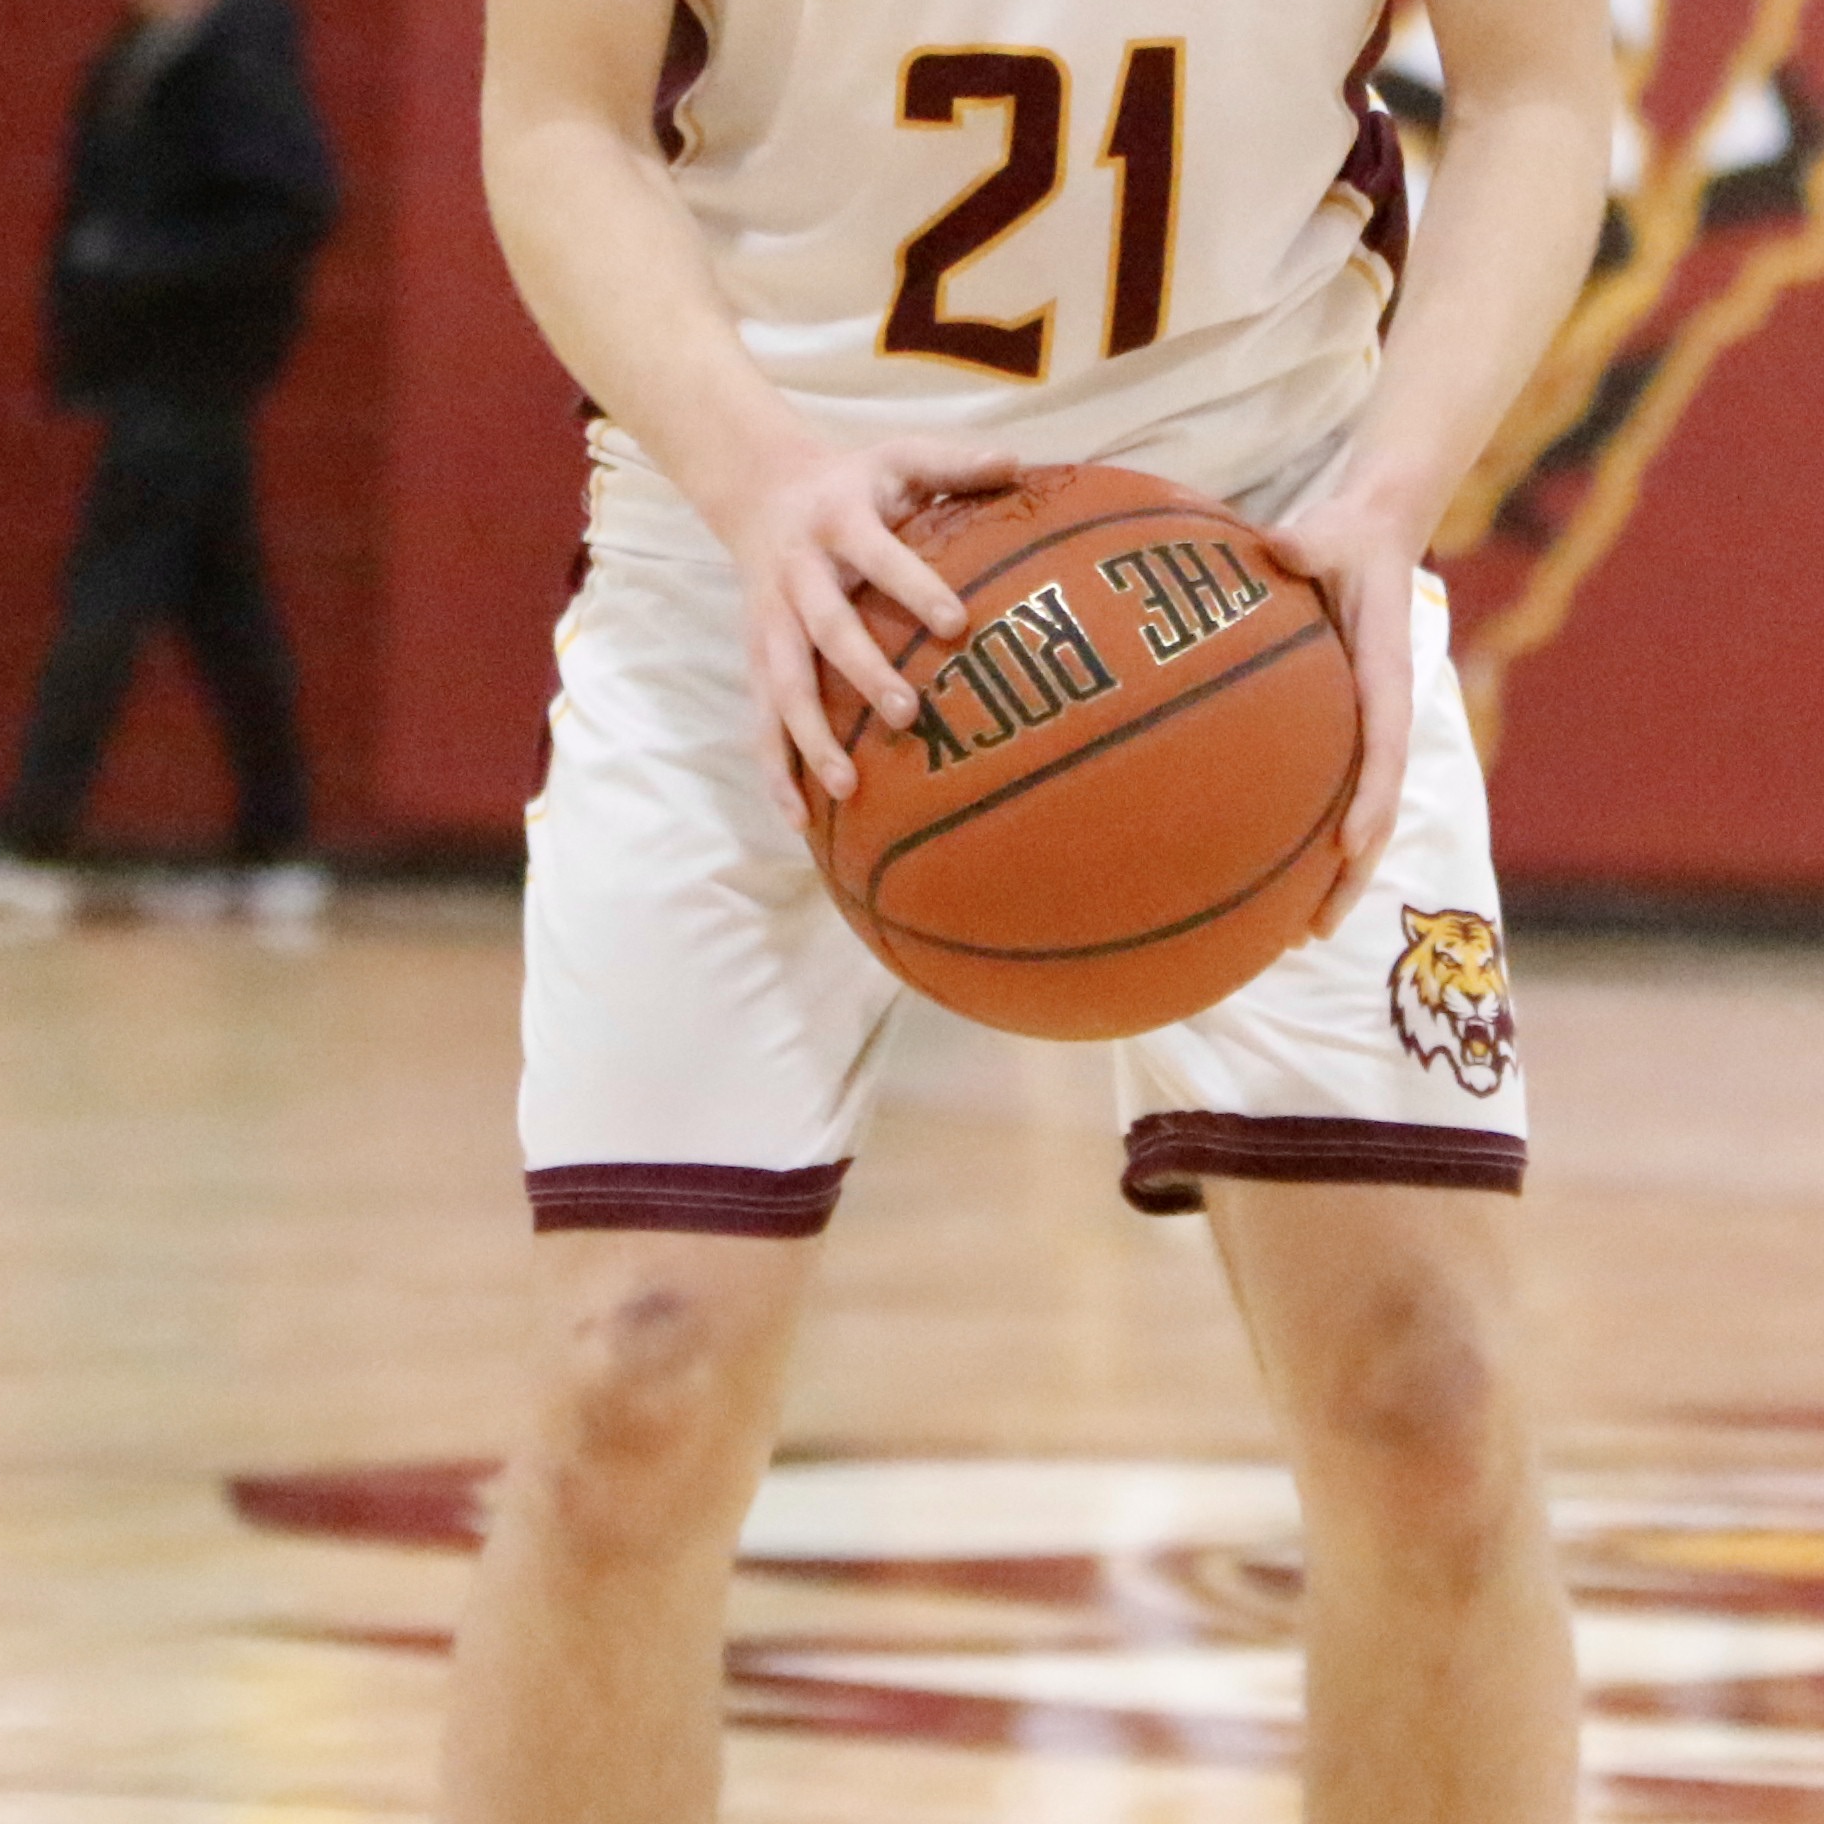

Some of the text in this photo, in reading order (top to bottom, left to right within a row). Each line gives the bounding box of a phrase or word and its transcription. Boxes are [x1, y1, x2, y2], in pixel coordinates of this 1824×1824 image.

[877, 37, 1187, 385] 21
[908, 540, 1269, 772] THE ROCK
